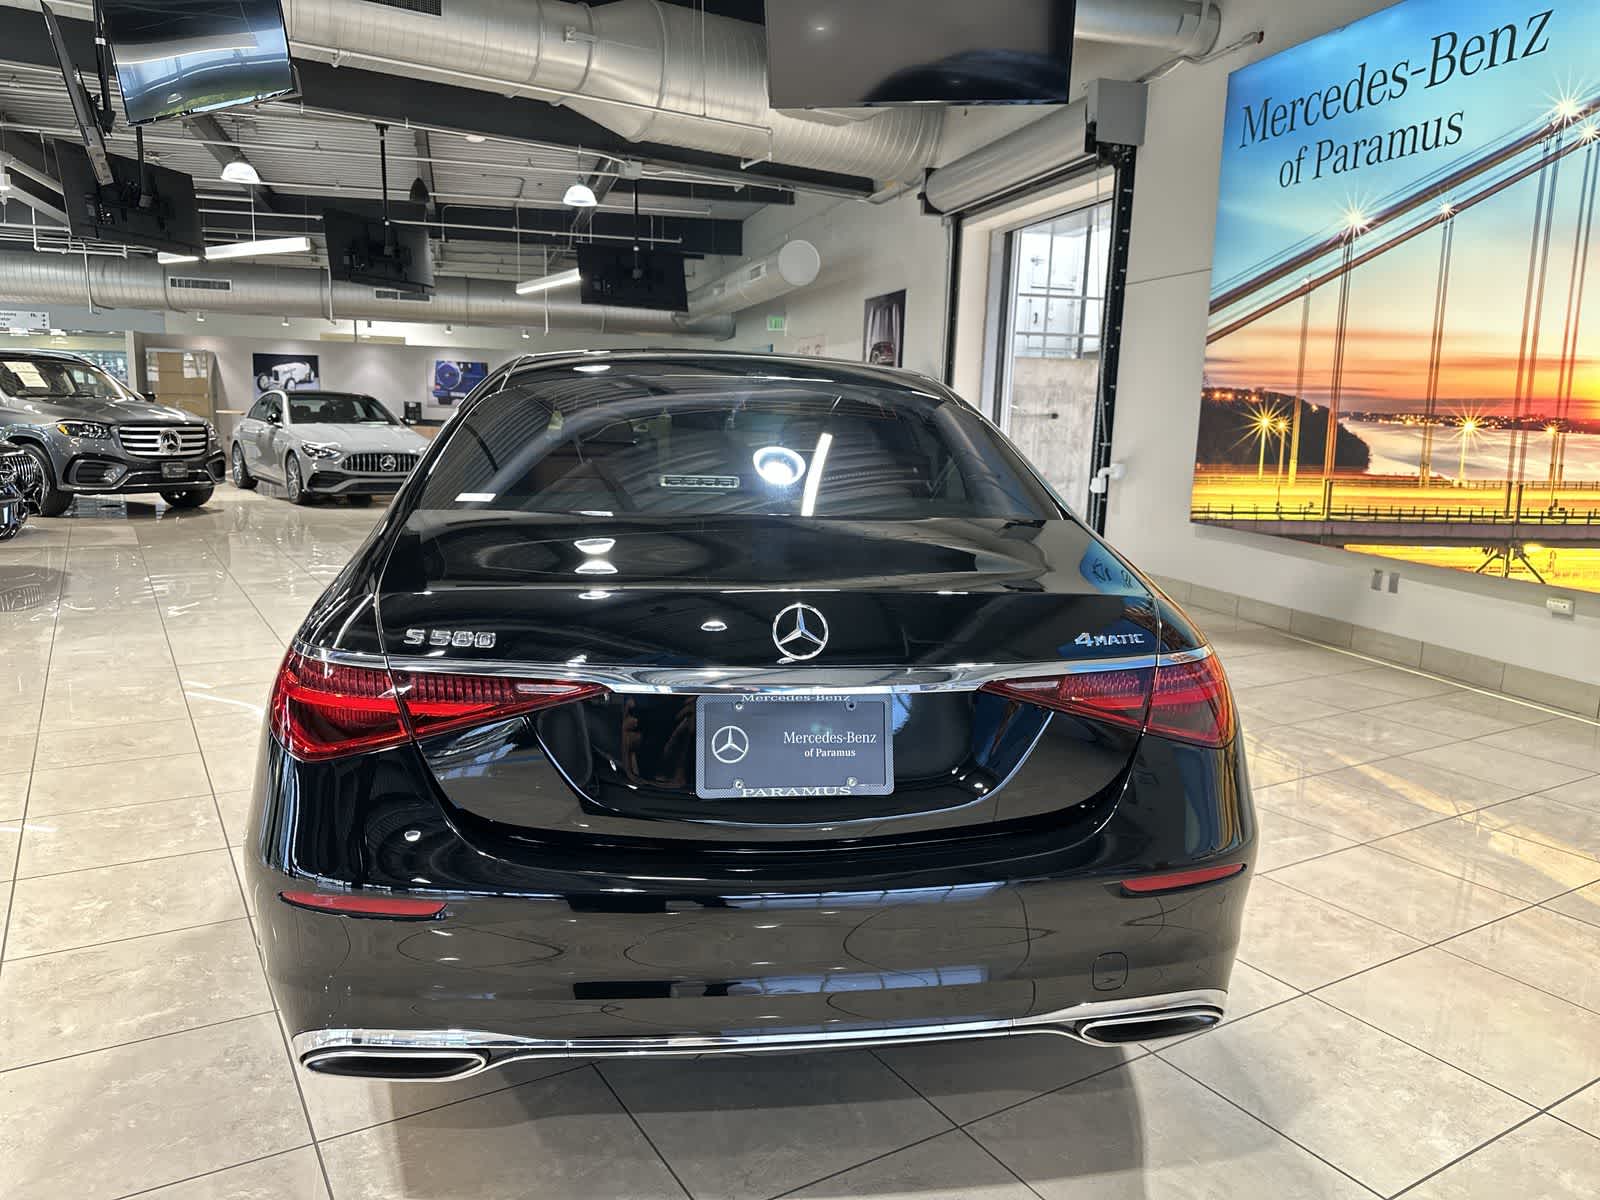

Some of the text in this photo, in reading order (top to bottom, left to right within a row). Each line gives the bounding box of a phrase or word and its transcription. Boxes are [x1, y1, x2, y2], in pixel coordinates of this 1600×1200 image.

[1239, 9, 1554, 149] Mercedes-Benz
[1279, 110, 1465, 189] of Paramus
[403, 628, 497, 649] S 580
[1074, 632, 1145, 647] 4MATIC
[741, 694, 851, 702] Mercedes-Benz
[783, 731, 877, 744] Mercedes-Benz
[804, 748, 856, 757] of Paramus
[741, 786, 852, 797] PARAMUS
